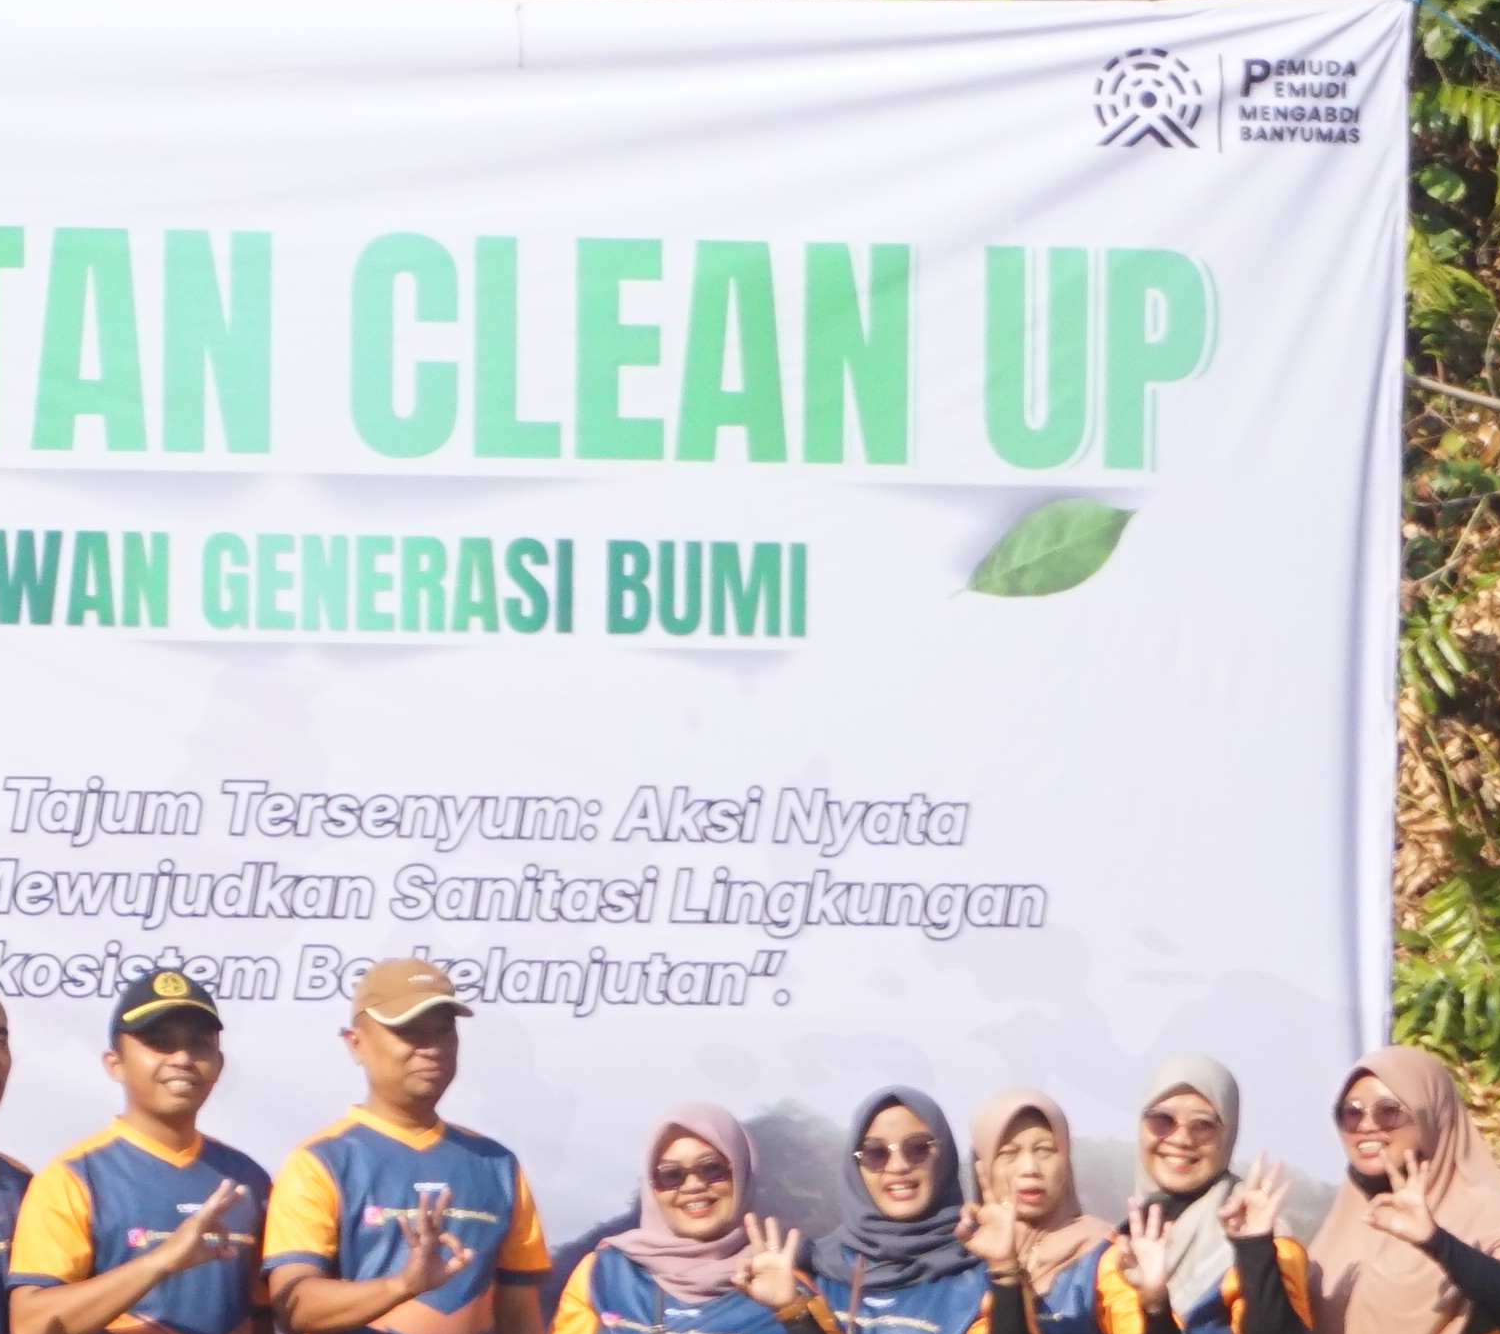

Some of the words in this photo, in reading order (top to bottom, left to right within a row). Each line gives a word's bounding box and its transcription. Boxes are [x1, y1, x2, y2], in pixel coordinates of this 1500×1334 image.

[1239, 104, 1360, 123] MENGABDI
[1240, 125, 1361, 144] BANYUMAS
[349, 231, 914, 465] CLEAN
[984, 244, 1218, 473] UP
[201, 531, 574, 634] GENERASI
[606, 539, 808, 638] BUMI
[4, 775, 201, 847] Tajum
[221, 779, 602, 853] Tersenyum:
[612, 785, 763, 844] Aksi
[772, 787, 969, 858] Nyata
[389, 863, 660, 924] Sanitasi
[669, 865, 1048, 941] Lingkungan
